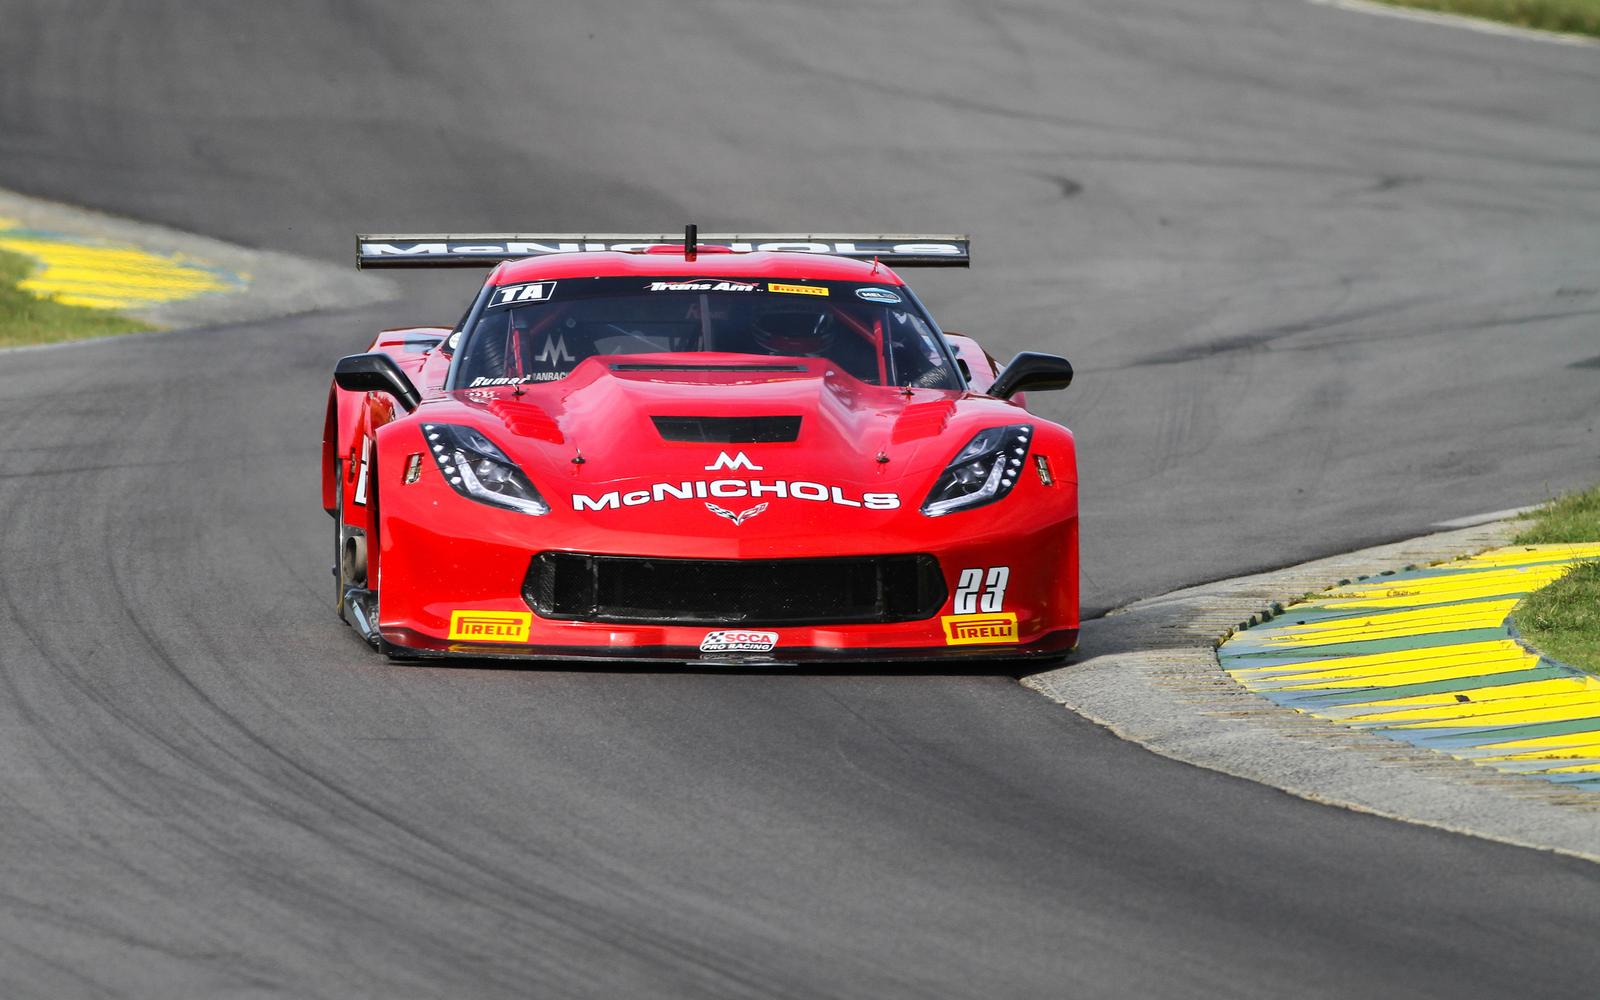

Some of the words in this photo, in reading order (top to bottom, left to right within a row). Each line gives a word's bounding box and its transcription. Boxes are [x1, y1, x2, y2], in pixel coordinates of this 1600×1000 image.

[501, 284, 543, 302] TA
[650, 282, 712, 291] Trans
[712, 282, 754, 291] Am
[571, 479, 902, 511] McNICHOLS
[953, 566, 1009, 615] 23
[456, 617, 524, 637] PIRELLI
[949, 619, 1014, 640] PIRELLI
[725, 634, 772, 644] SCCA
